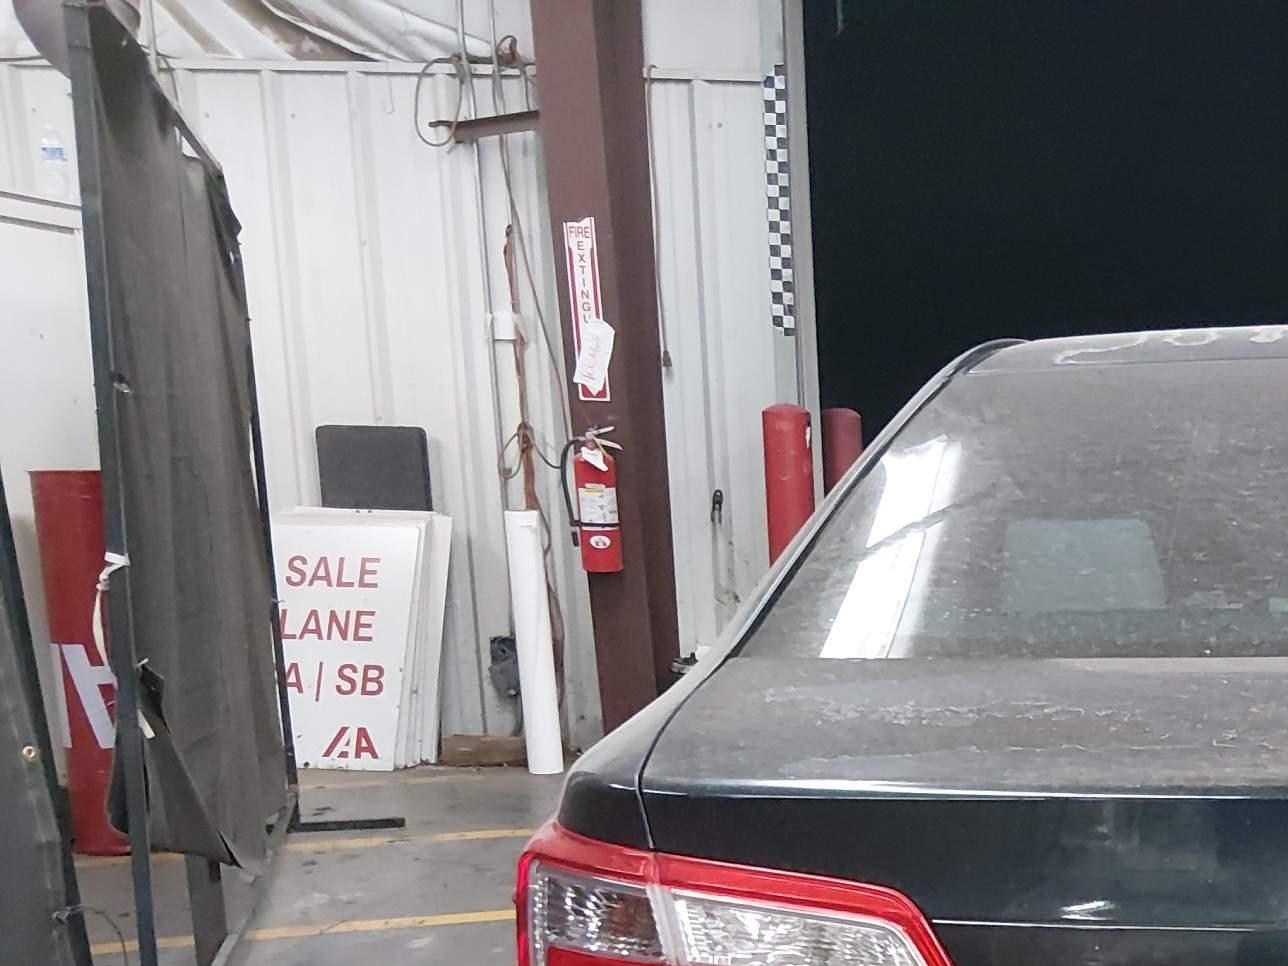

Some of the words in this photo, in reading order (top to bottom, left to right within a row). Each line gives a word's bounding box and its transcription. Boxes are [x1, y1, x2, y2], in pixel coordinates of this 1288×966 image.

[568, 226, 592, 239] FIRE
[285, 555, 382, 589] SALE
[279, 608, 376, 642] LANE
[335, 663, 385, 696] SB
